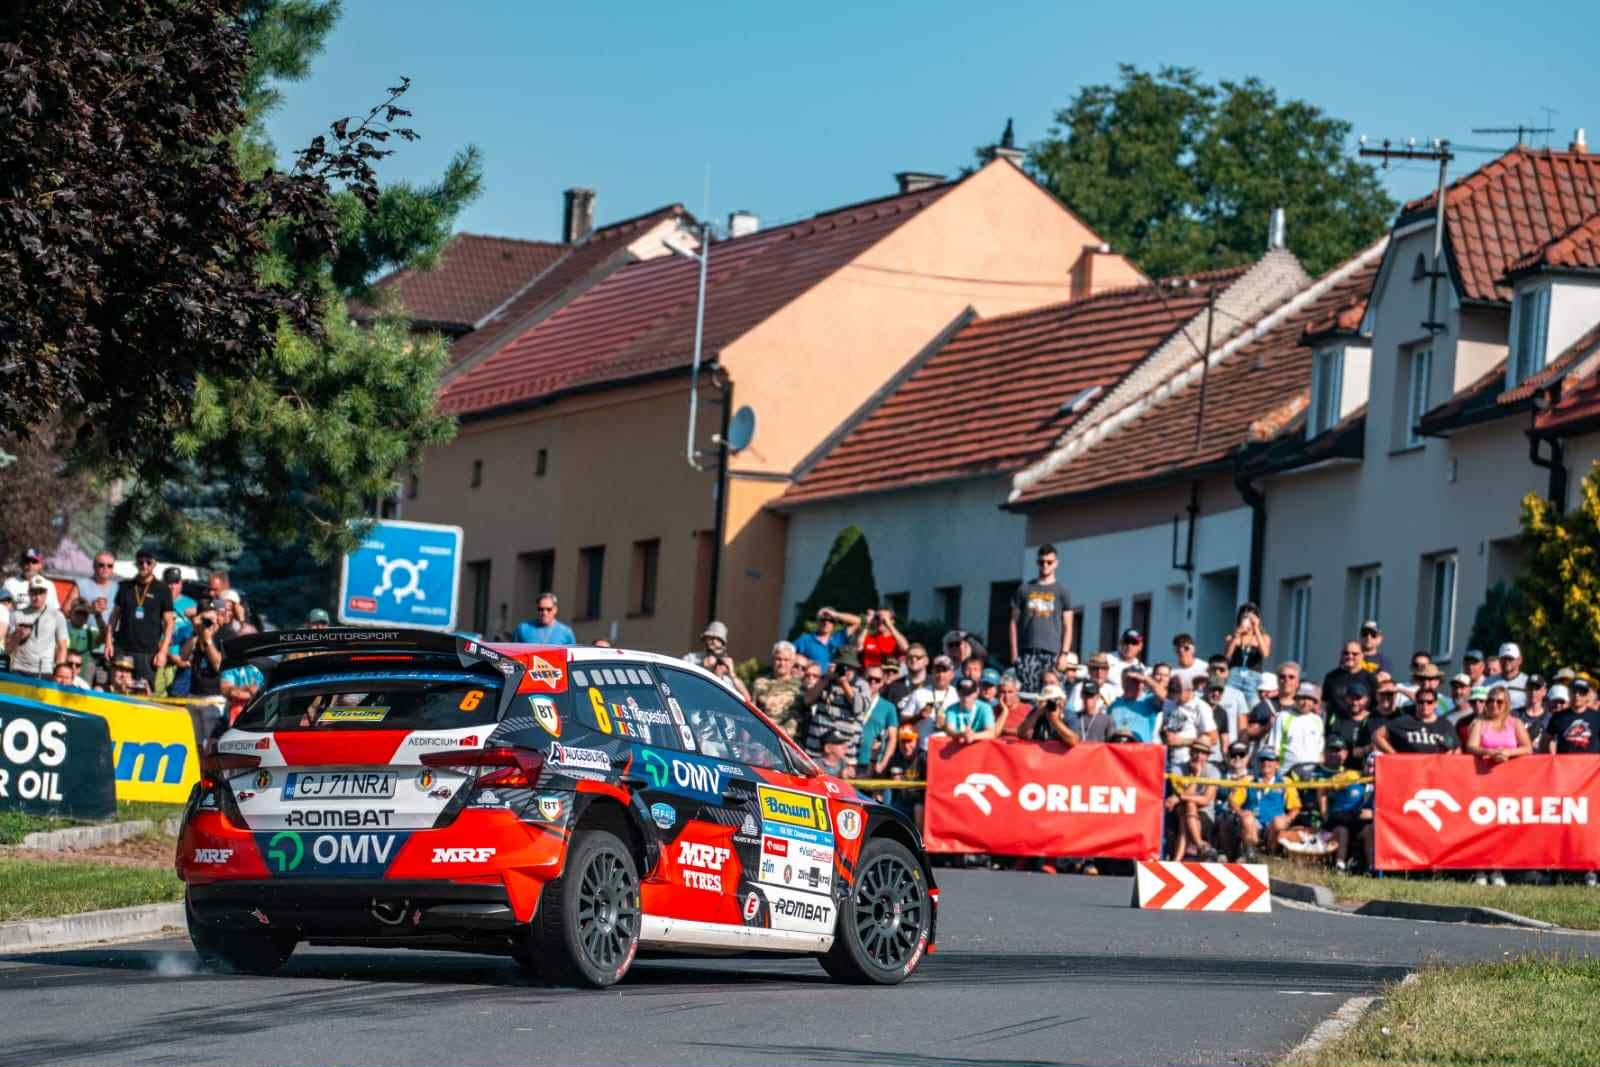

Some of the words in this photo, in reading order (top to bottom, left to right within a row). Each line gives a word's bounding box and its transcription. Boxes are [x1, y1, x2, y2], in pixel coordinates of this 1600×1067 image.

[458, 690, 485, 712] 6
[536, 704, 553, 721] BT
[587, 686, 613, 735] 6
[18, 770, 63, 801] OIL
[300, 775, 324, 795] CJ
[672, 759, 720, 795] OMV
[1018, 783, 1137, 814] ORLEN
[1468, 796, 1589, 825] ORLEN
[285, 810, 396, 827] ROMBAT
[815, 798, 828, 831] 6
[193, 848, 234, 864] MRF
[313, 834, 396, 864] OMV
[431, 848, 497, 863] MRF
[677, 841, 731, 871] MRF
[682, 869, 722, 893] TYRES
[774, 897, 831, 924] ROMBAT
